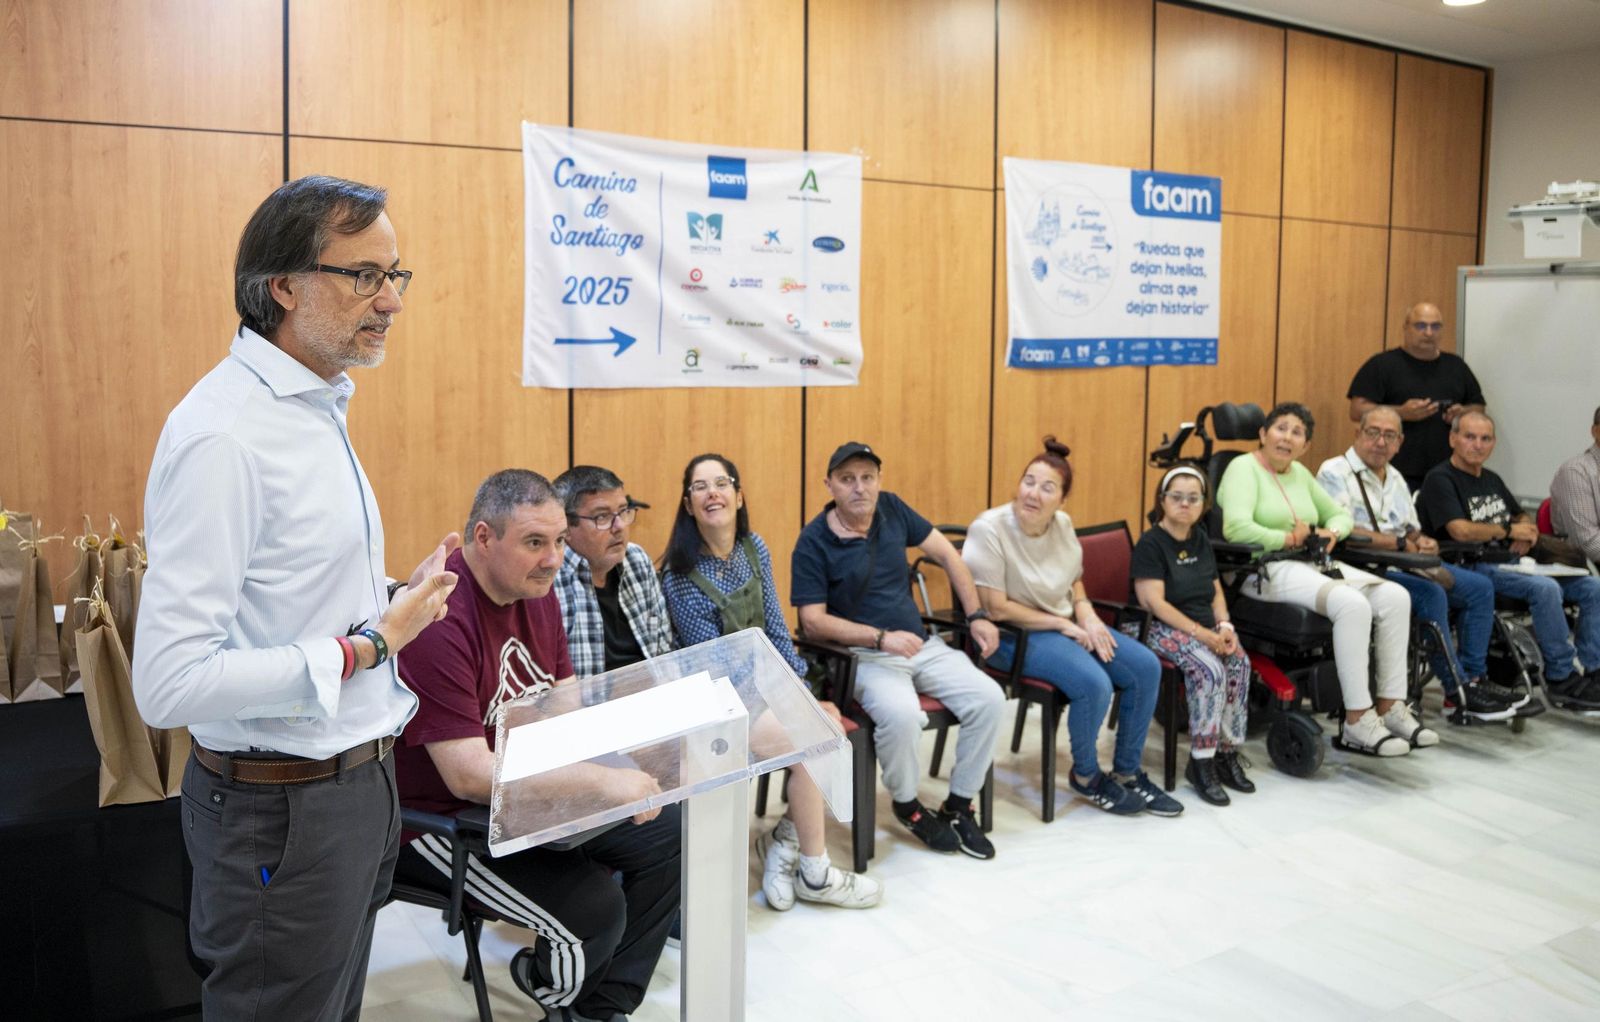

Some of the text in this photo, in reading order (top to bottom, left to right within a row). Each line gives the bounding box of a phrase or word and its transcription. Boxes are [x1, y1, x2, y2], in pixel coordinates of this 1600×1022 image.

[554, 157, 637, 193] Camino
[710, 170, 746, 186] faam
[1142, 177, 1213, 215] faam
[584, 195, 609, 218] de
[550, 214, 644, 256] Santiago
[1184, 245, 1205, 260] que
[1130, 261, 1162, 277] dejan
[562, 276, 633, 305] 2025
[1139, 281, 1198, 297] almas que
[1126, 301, 1158, 317] dejan
[1020, 347, 1055, 362] faam
